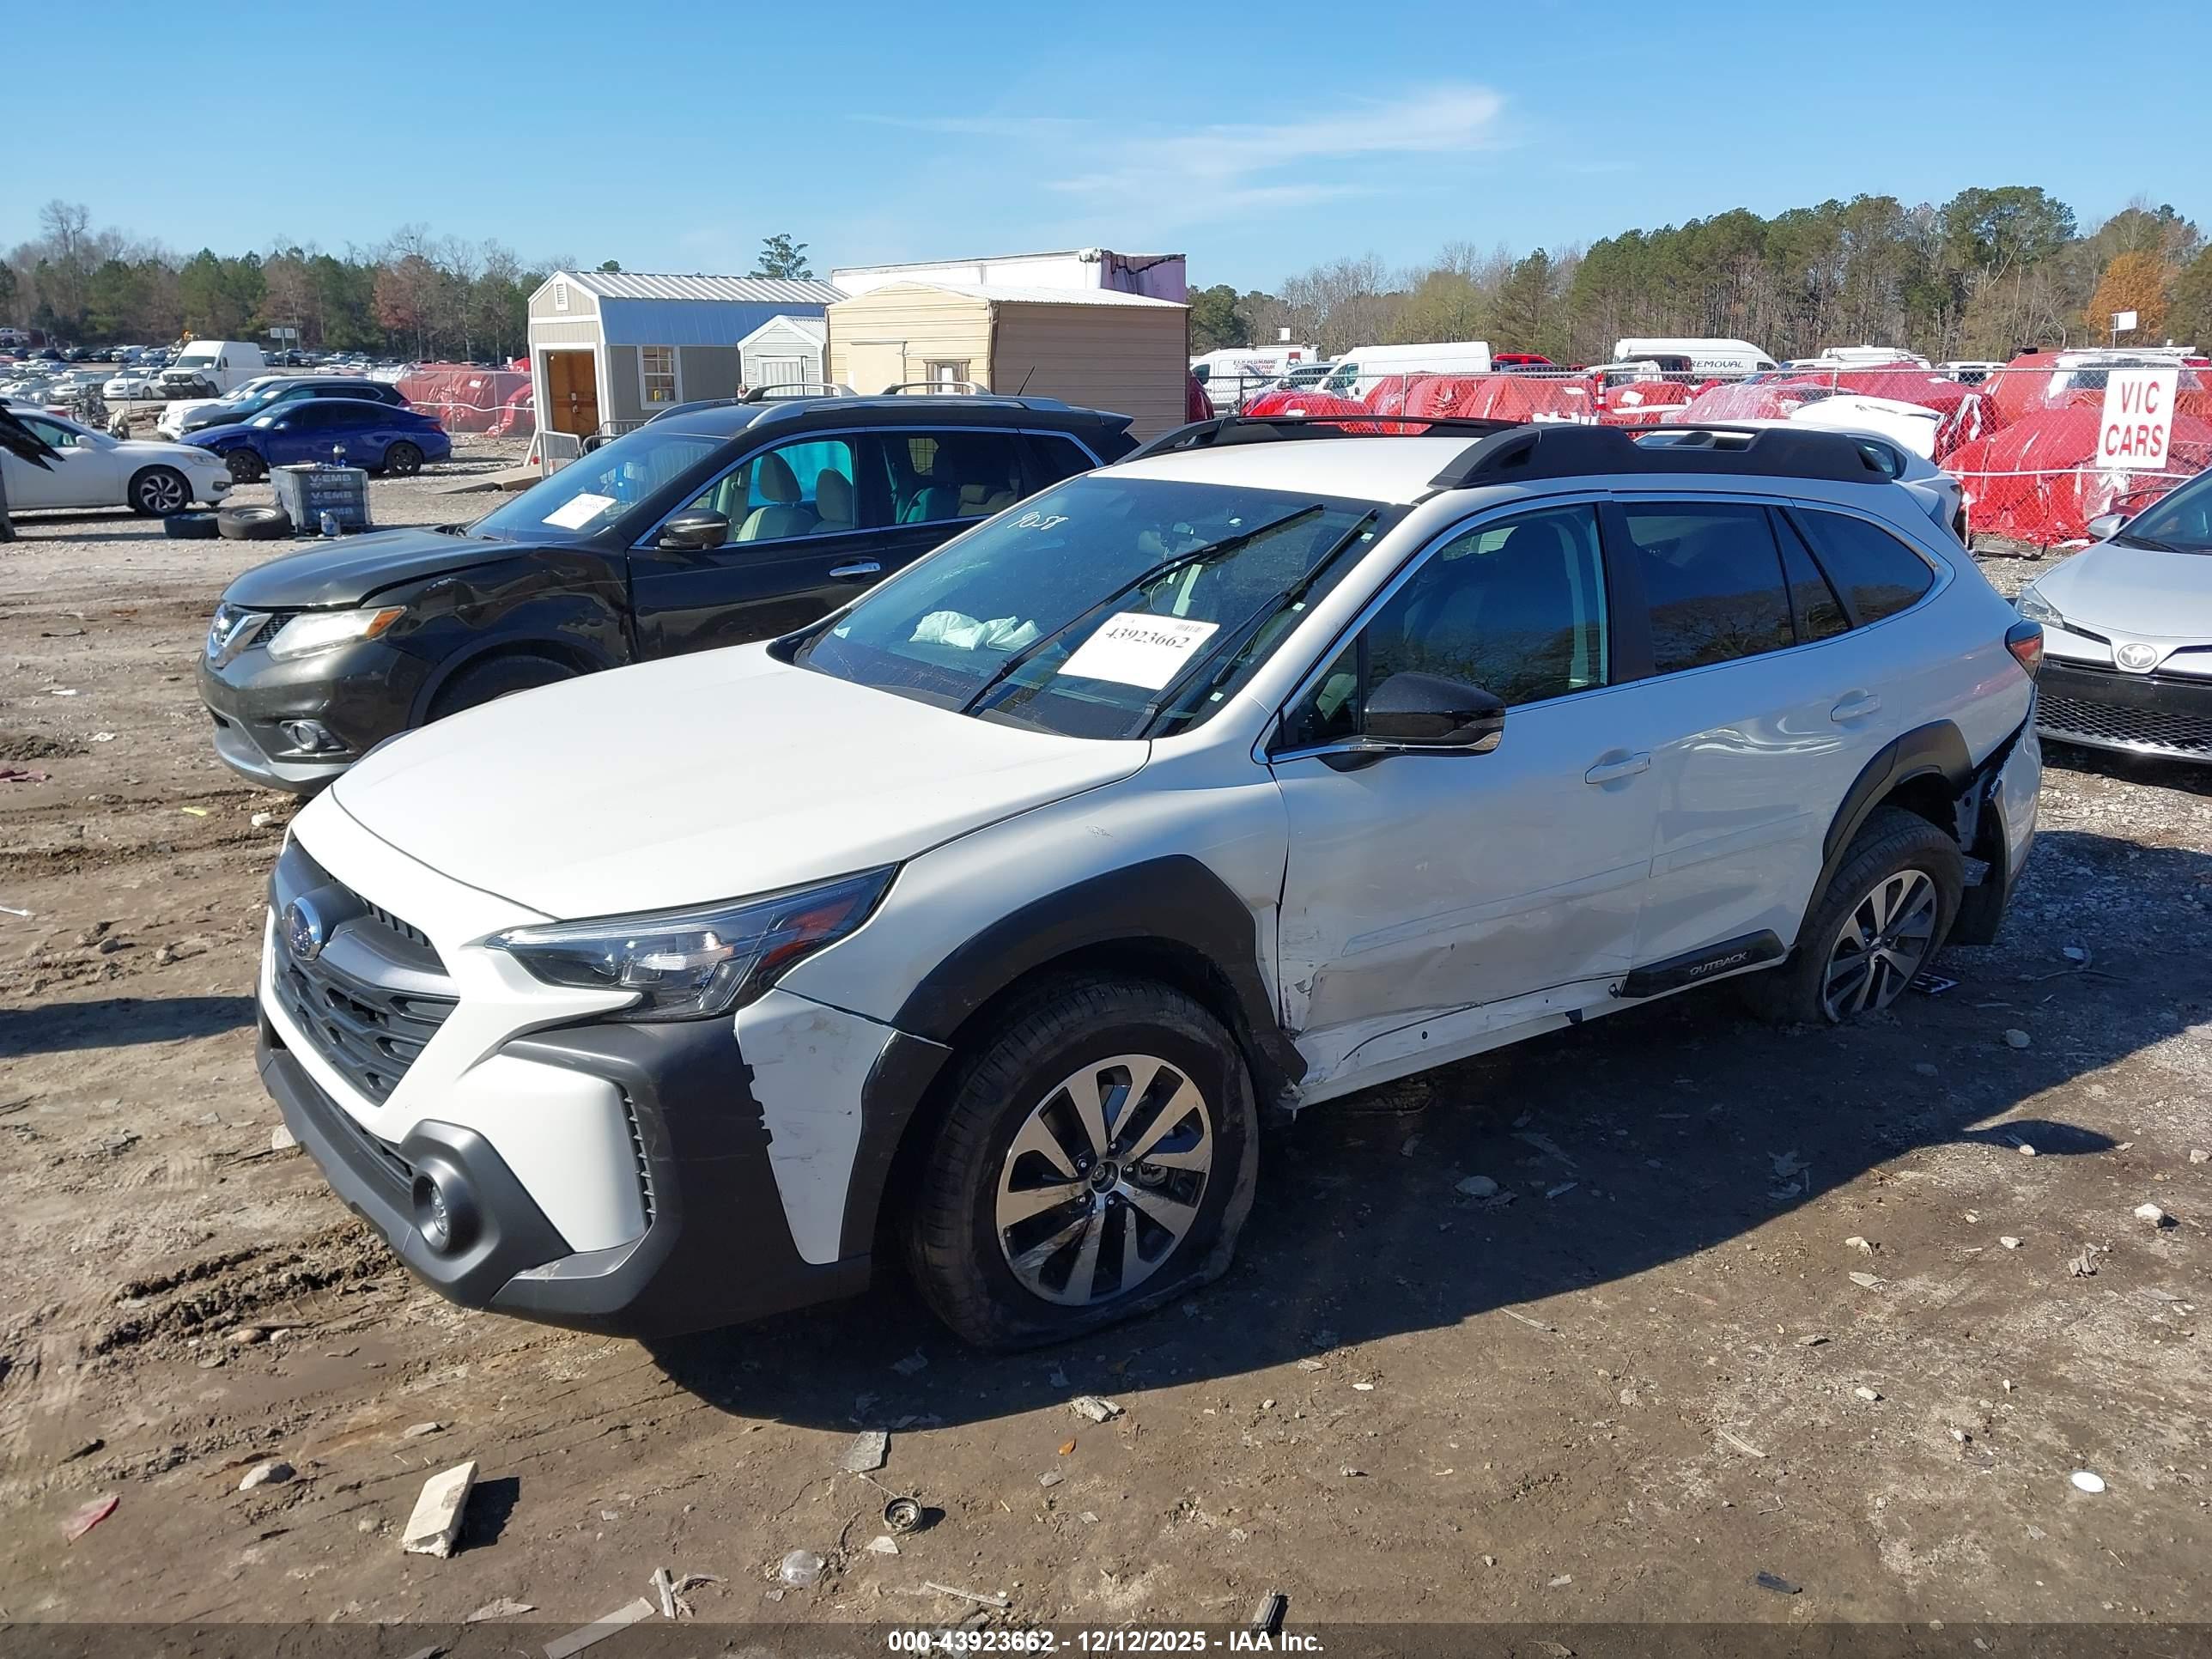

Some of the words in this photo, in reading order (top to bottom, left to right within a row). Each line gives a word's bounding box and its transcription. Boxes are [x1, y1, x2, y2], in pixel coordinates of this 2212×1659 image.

[2122, 381, 2160, 414] VIC
[2106, 424, 2164, 457] CARS
[1105, 628, 1190, 648] 43923662
[1689, 951, 1748, 976] OUTBACK
